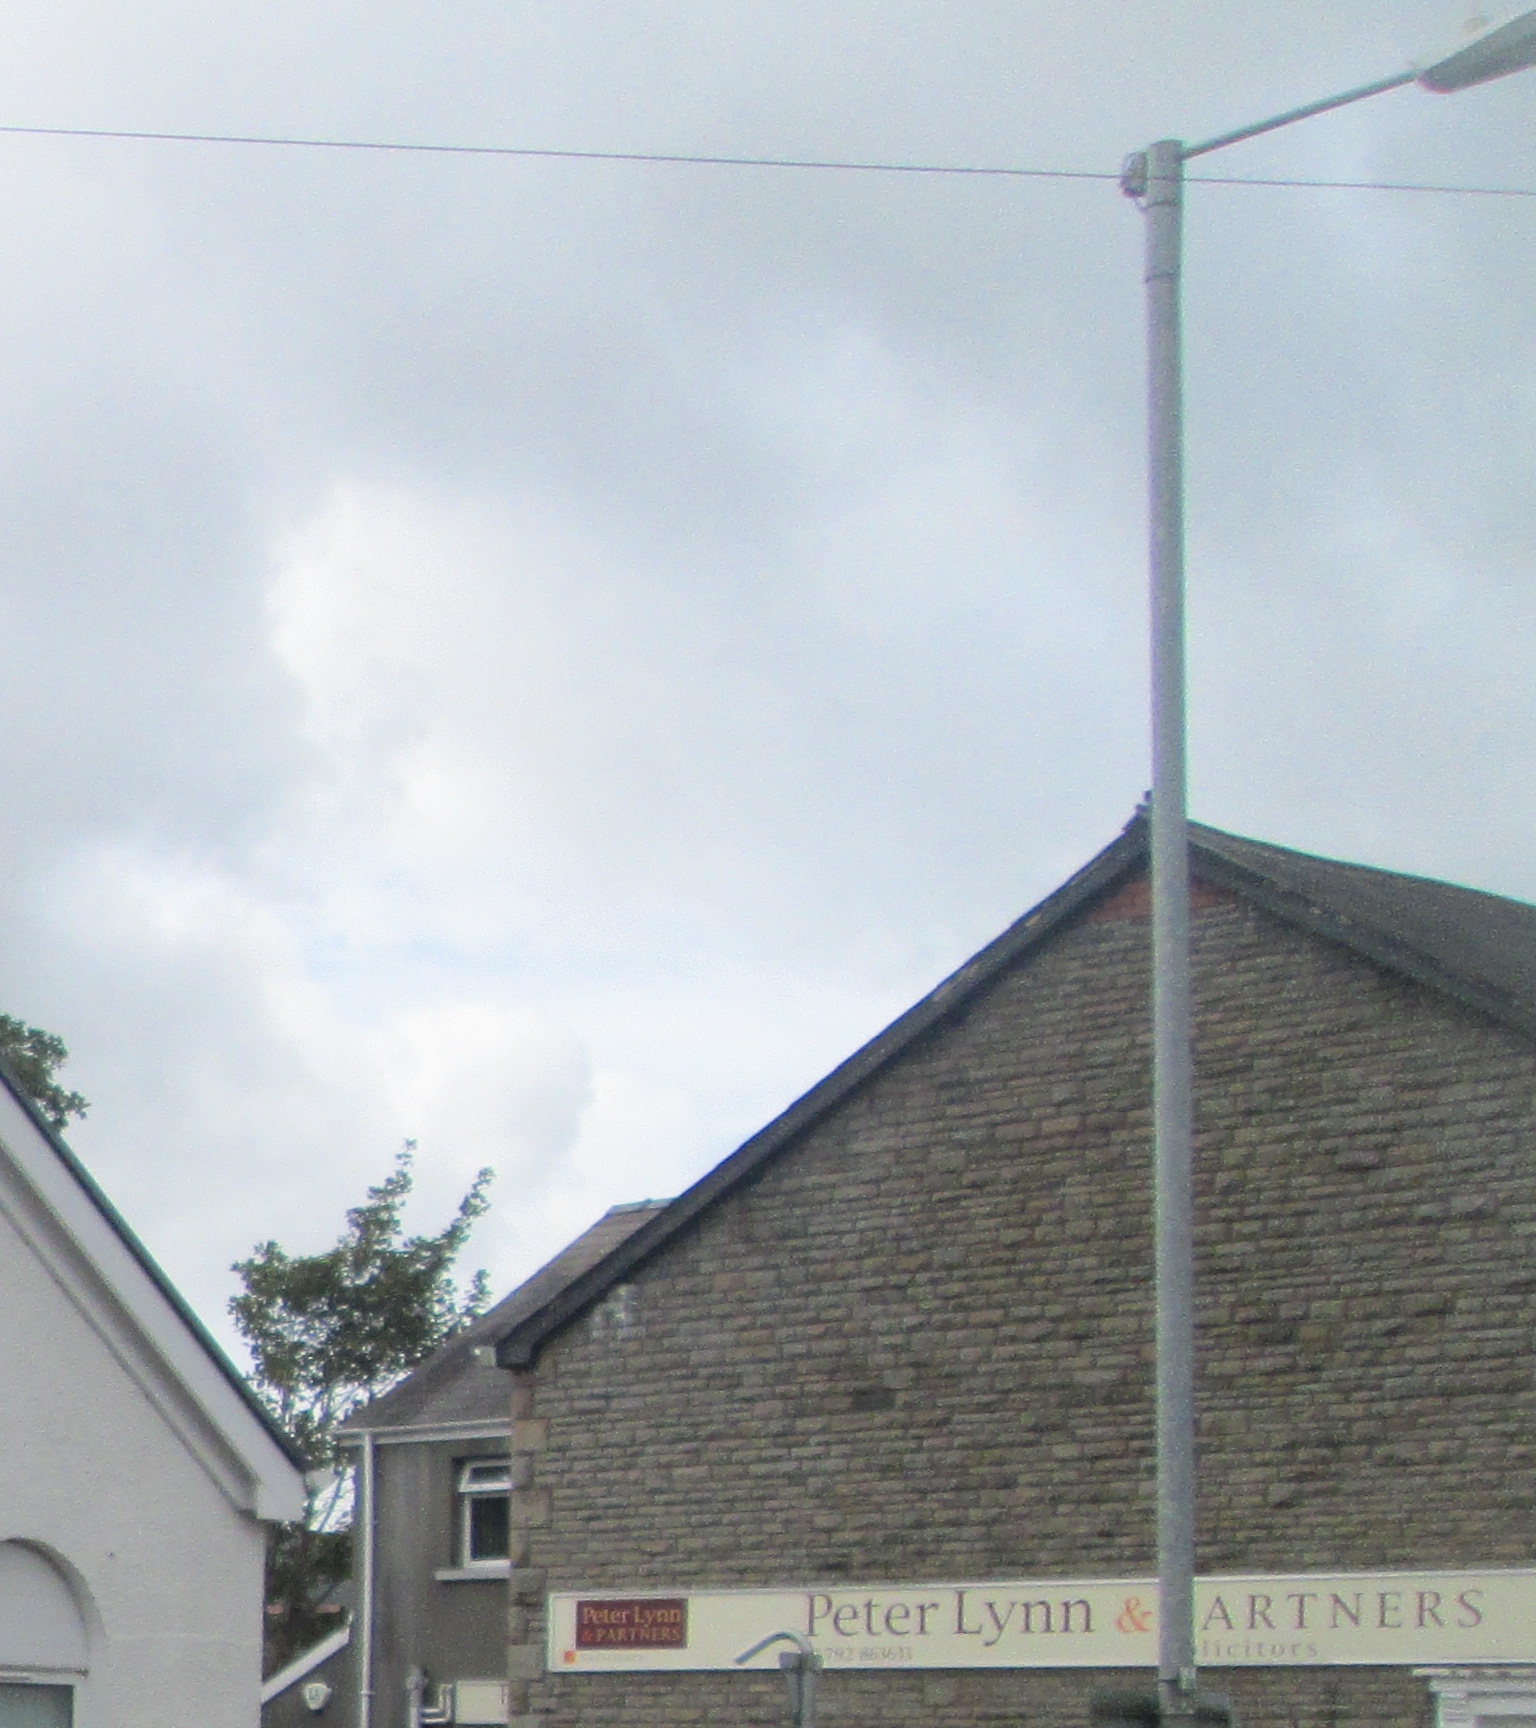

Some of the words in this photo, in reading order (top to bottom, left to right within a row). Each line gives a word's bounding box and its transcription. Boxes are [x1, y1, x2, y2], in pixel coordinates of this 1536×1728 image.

[583, 1606, 629, 1624] Peter
[633, 1605, 682, 1627] Lynn
[806, 1592, 939, 1637] Peter
[953, 1589, 1095, 1647] Lynn
[1115, 1596, 1153, 1635] &
[1201, 1589, 1485, 1631] ARTNERS
[596, 1627, 681, 1642] PARTNERS
[825, 1646, 855, 1661] 792
[1202, 1637, 1317, 1658] licitors
